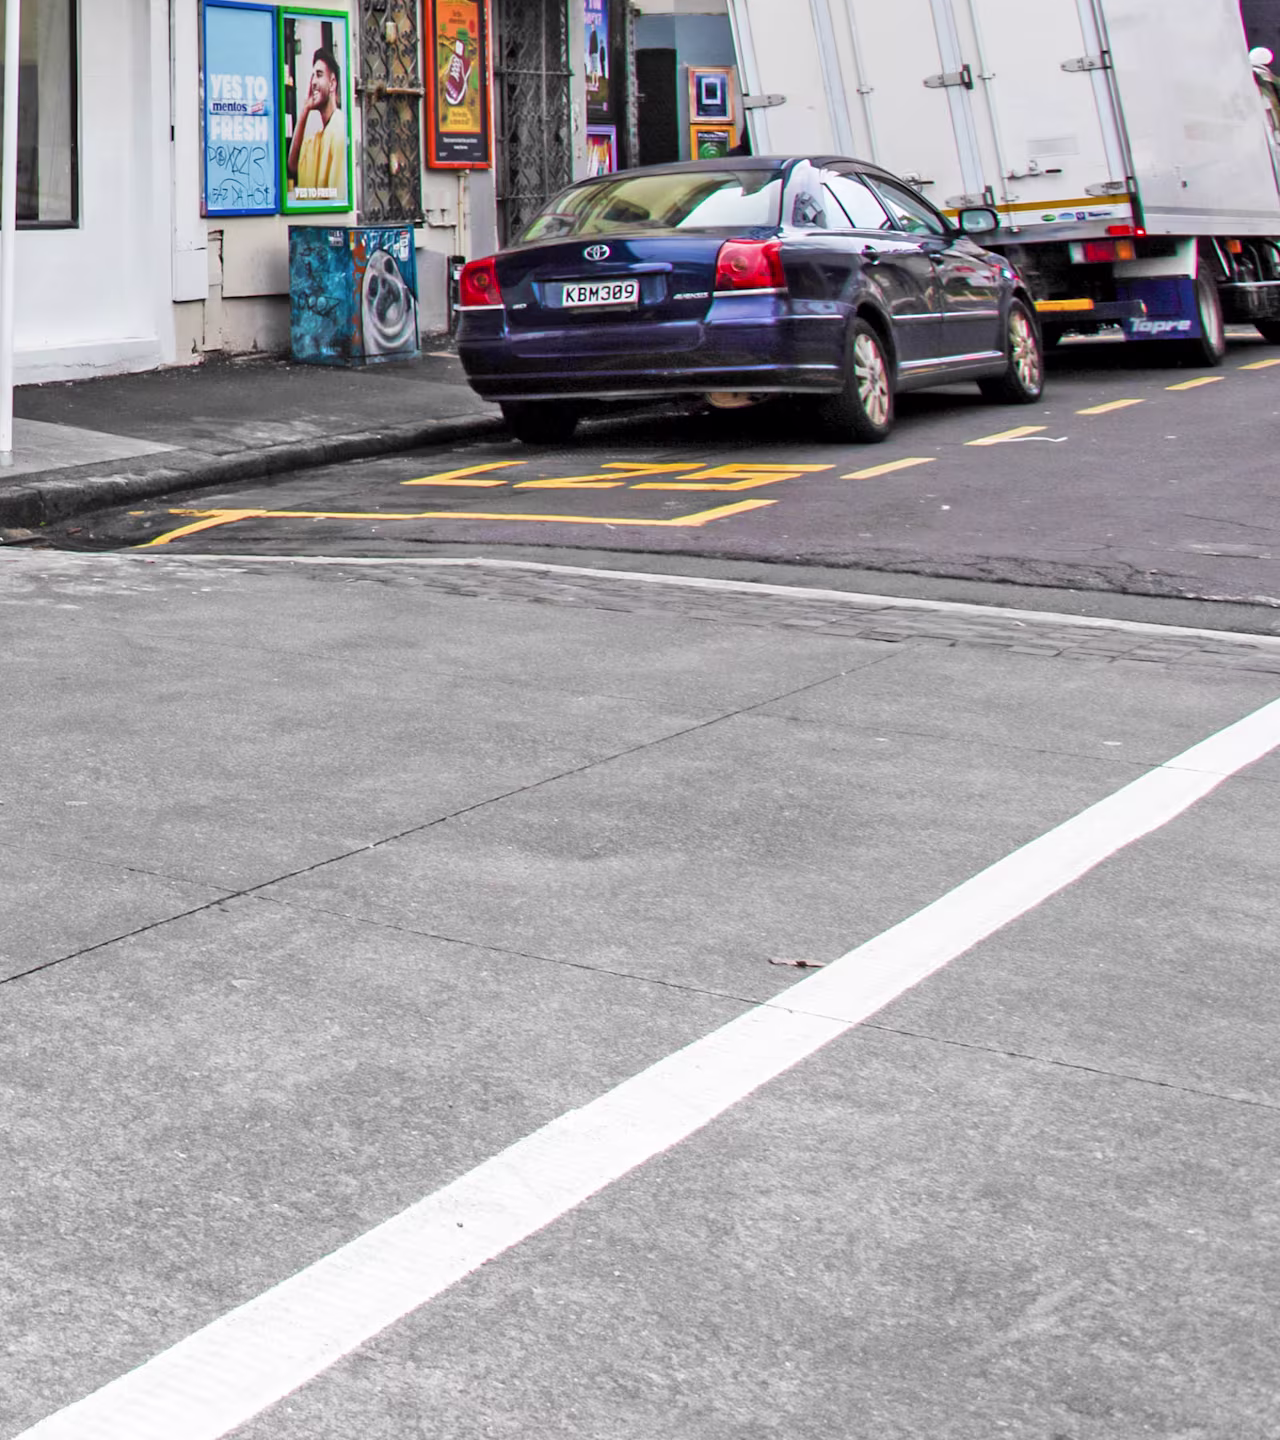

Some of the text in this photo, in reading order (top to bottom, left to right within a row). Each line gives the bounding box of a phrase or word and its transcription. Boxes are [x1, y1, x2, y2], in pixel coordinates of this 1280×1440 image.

[210, 74, 268, 103] YES TO
[212, 101, 247, 112] mentos
[210, 116, 268, 142] FRESH
[295, 187, 338, 198] YES TO FRESH
[565, 283, 635, 305] KBM309
[1129, 317, 1192, 333] Topre
